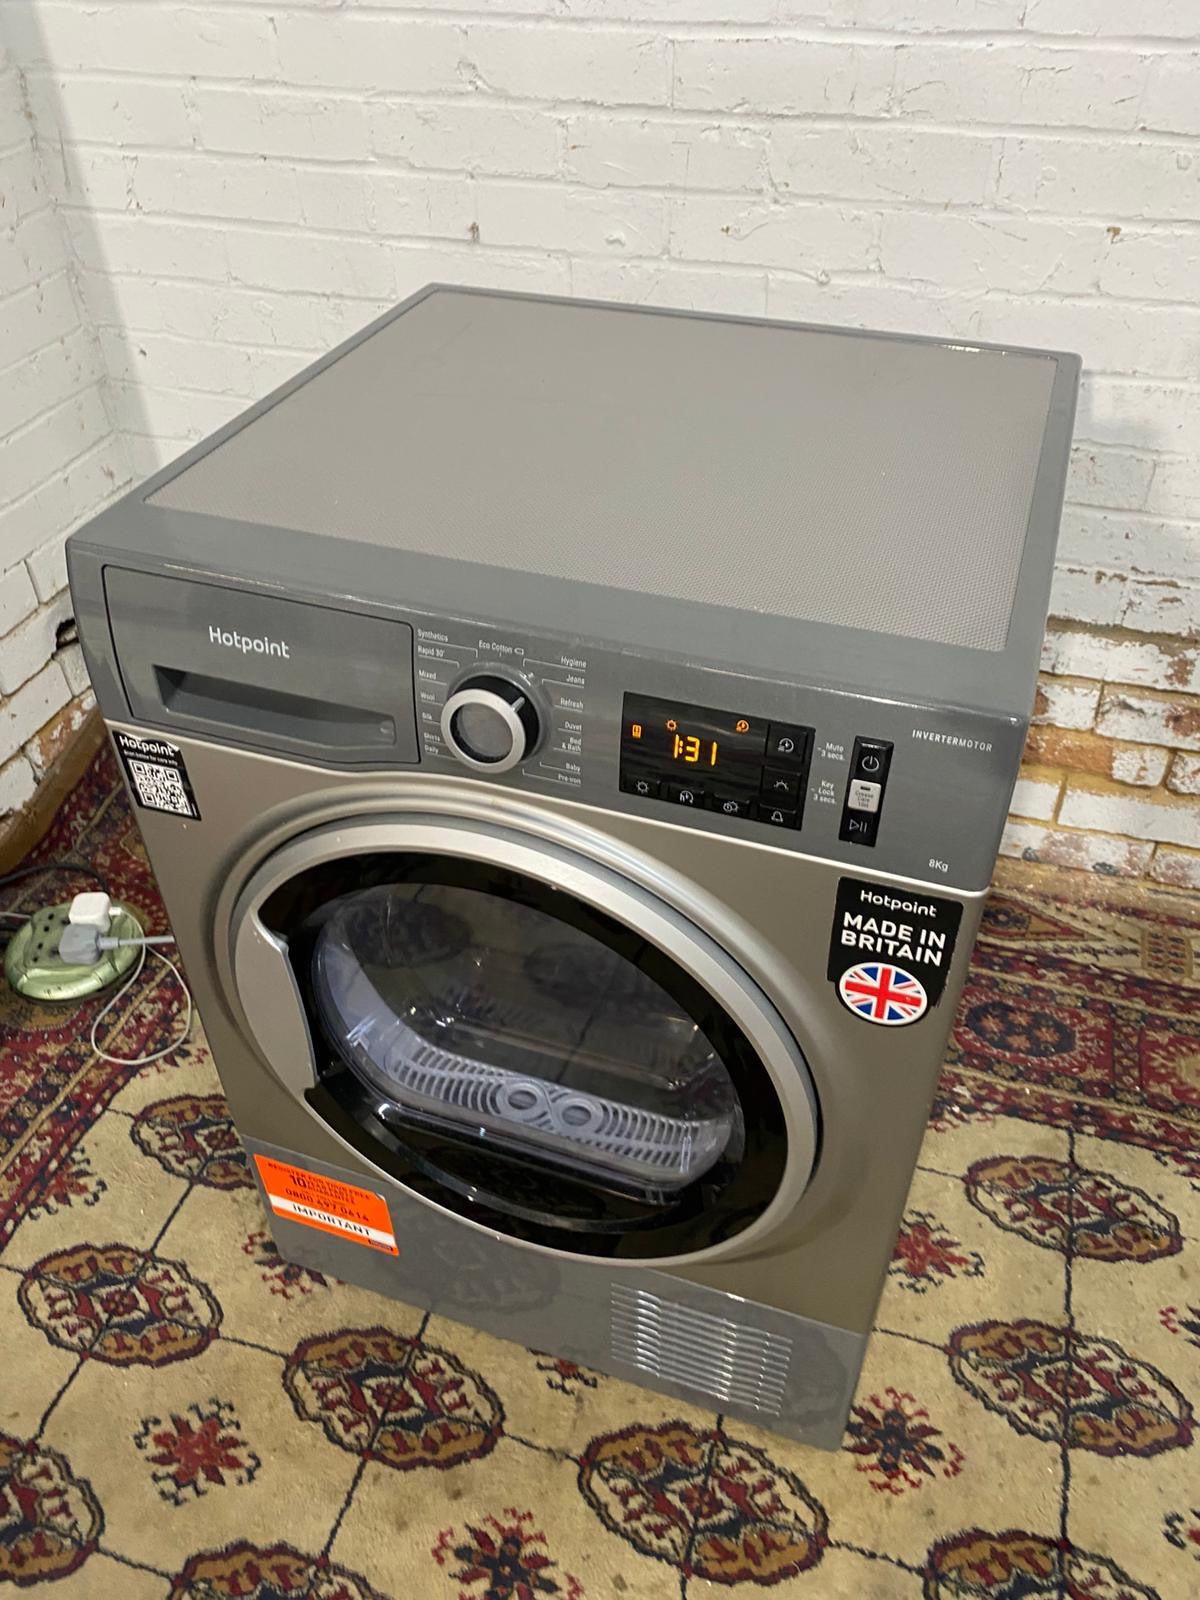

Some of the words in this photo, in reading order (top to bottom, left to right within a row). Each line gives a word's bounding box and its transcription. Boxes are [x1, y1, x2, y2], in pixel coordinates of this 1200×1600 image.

[208, 624, 290, 659] Hotpoint
[417, 628, 449, 643] Synthetics
[417, 645, 435, 656] Rapid
[478, 639, 491, 649] Eco
[491, 642, 513, 655] Cotton
[560, 655, 587, 669] Hygiene
[418, 669, 437, 681] Mixed
[566, 674, 585, 685] Jeans
[420, 691, 436, 701] Wool
[560, 697, 584, 710] Refresh
[564, 721, 582, 731] Duvet
[118, 735, 175, 757] Hotpoint
[569, 736, 582, 746] Bed
[911, 728, 994, 752] INVERTERMOTOR
[567, 743, 582, 752] Bath
[673, 734, 718, 767] 1:31
[825, 742, 845, 753] Mute
[565, 762, 581, 773] Baby
[818, 787, 835, 797] Lock
[821, 780, 835, 790] Key
[928, 858, 949, 873] 8Kg
[860, 889, 938, 918] Hotpoint
[843, 911, 914, 943] MADE
[919, 928, 946, 950] IN
[840, 929, 943, 967] BRITAIN
[288, 1174, 307, 1189] 10
[292, 1203, 371, 1236] IMPORTANT
